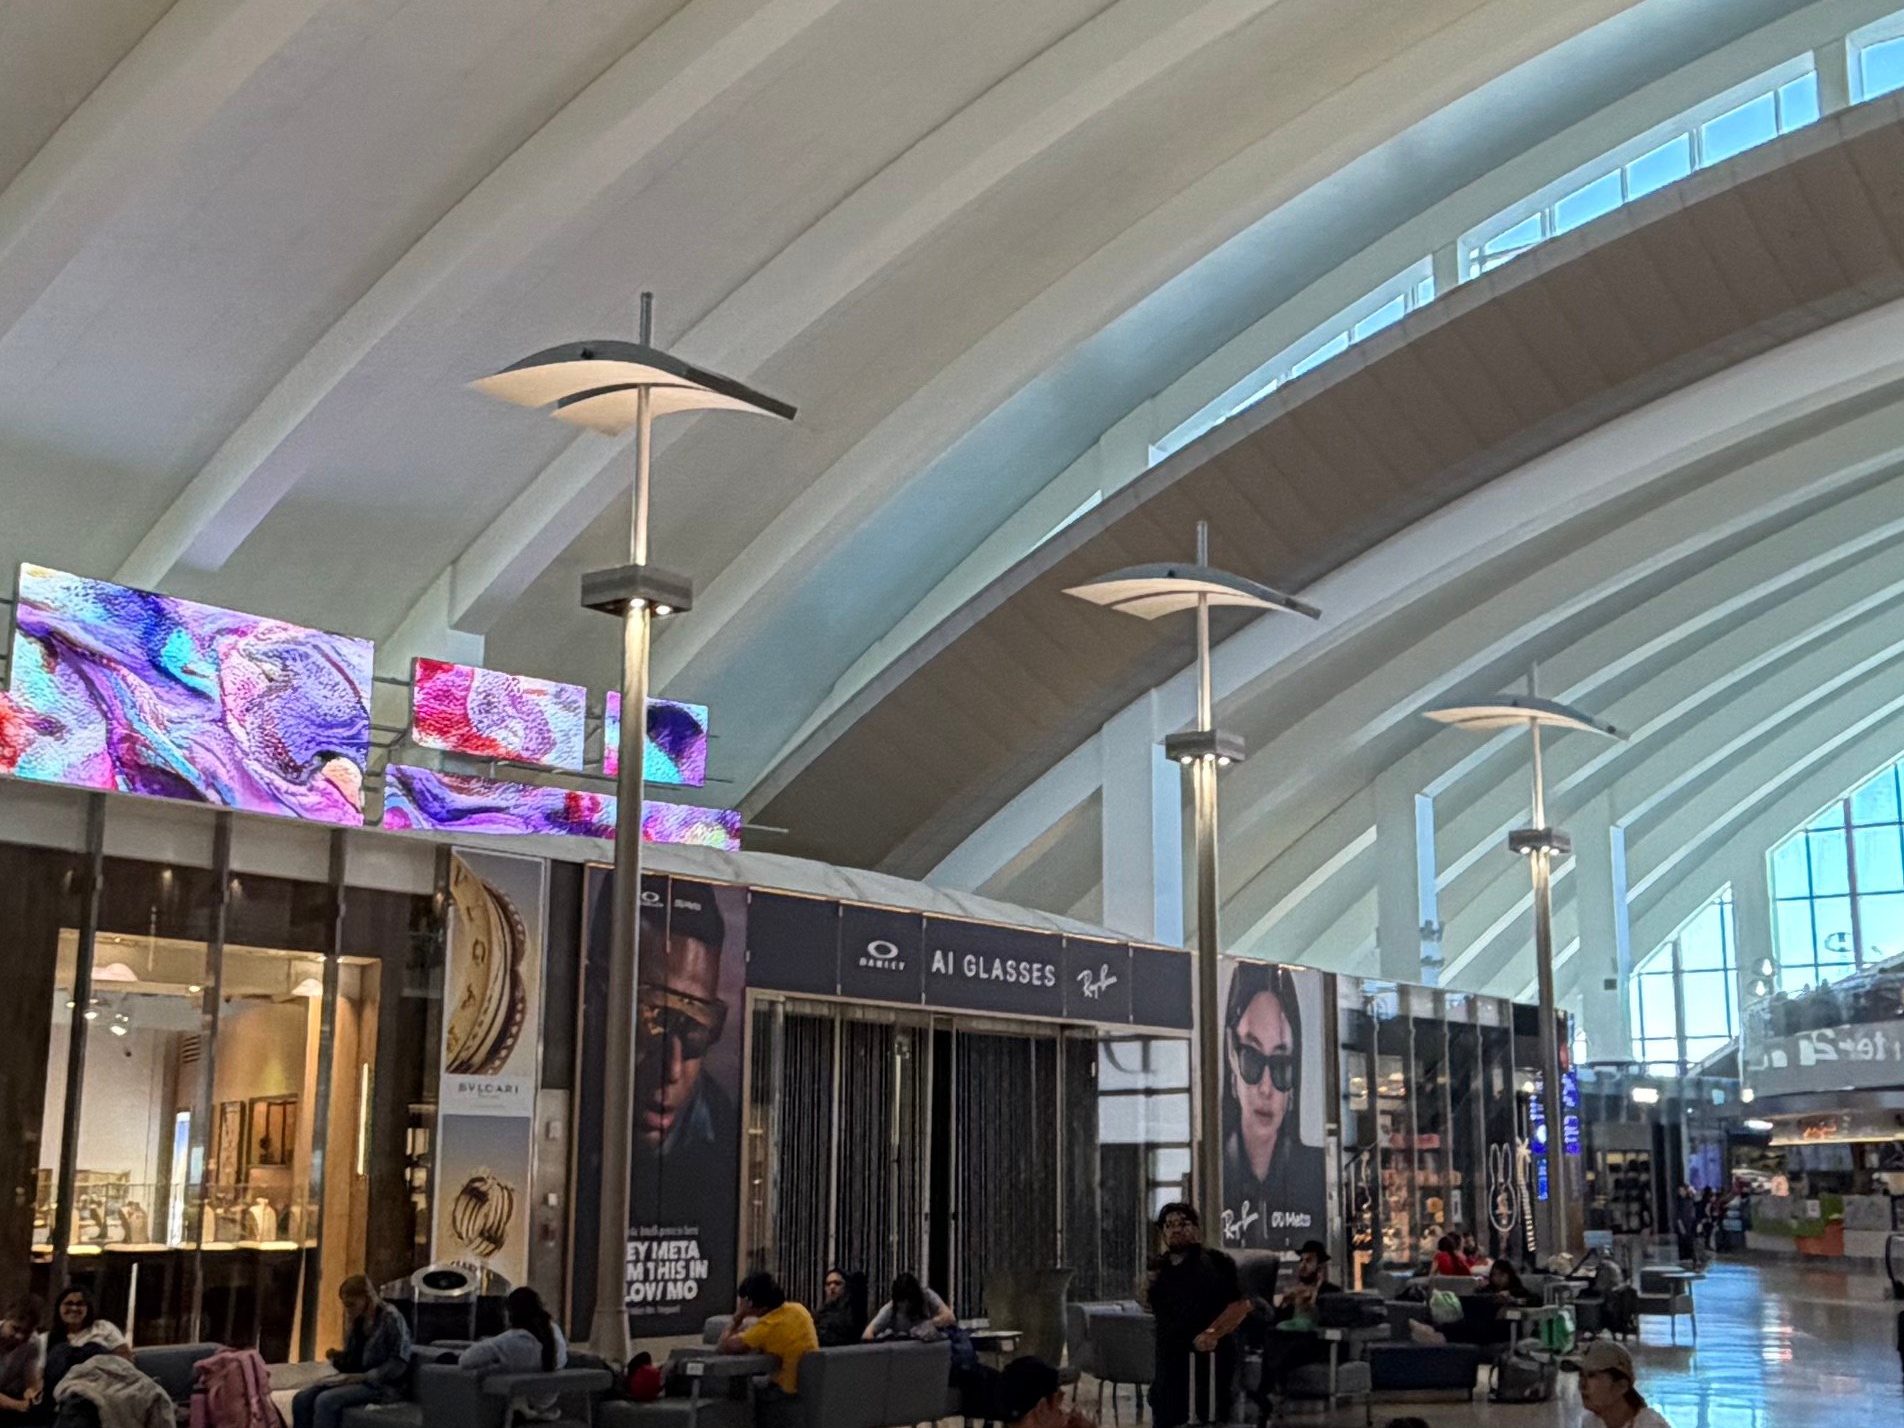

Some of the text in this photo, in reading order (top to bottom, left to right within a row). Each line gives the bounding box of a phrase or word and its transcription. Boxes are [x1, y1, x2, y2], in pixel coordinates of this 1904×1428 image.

[931, 949, 1056, 987] AI GLASSES
[627, 1240, 700, 1260] EY META
[647, 1260, 686, 1281] THIS
[689, 1260, 708, 1280] IN
